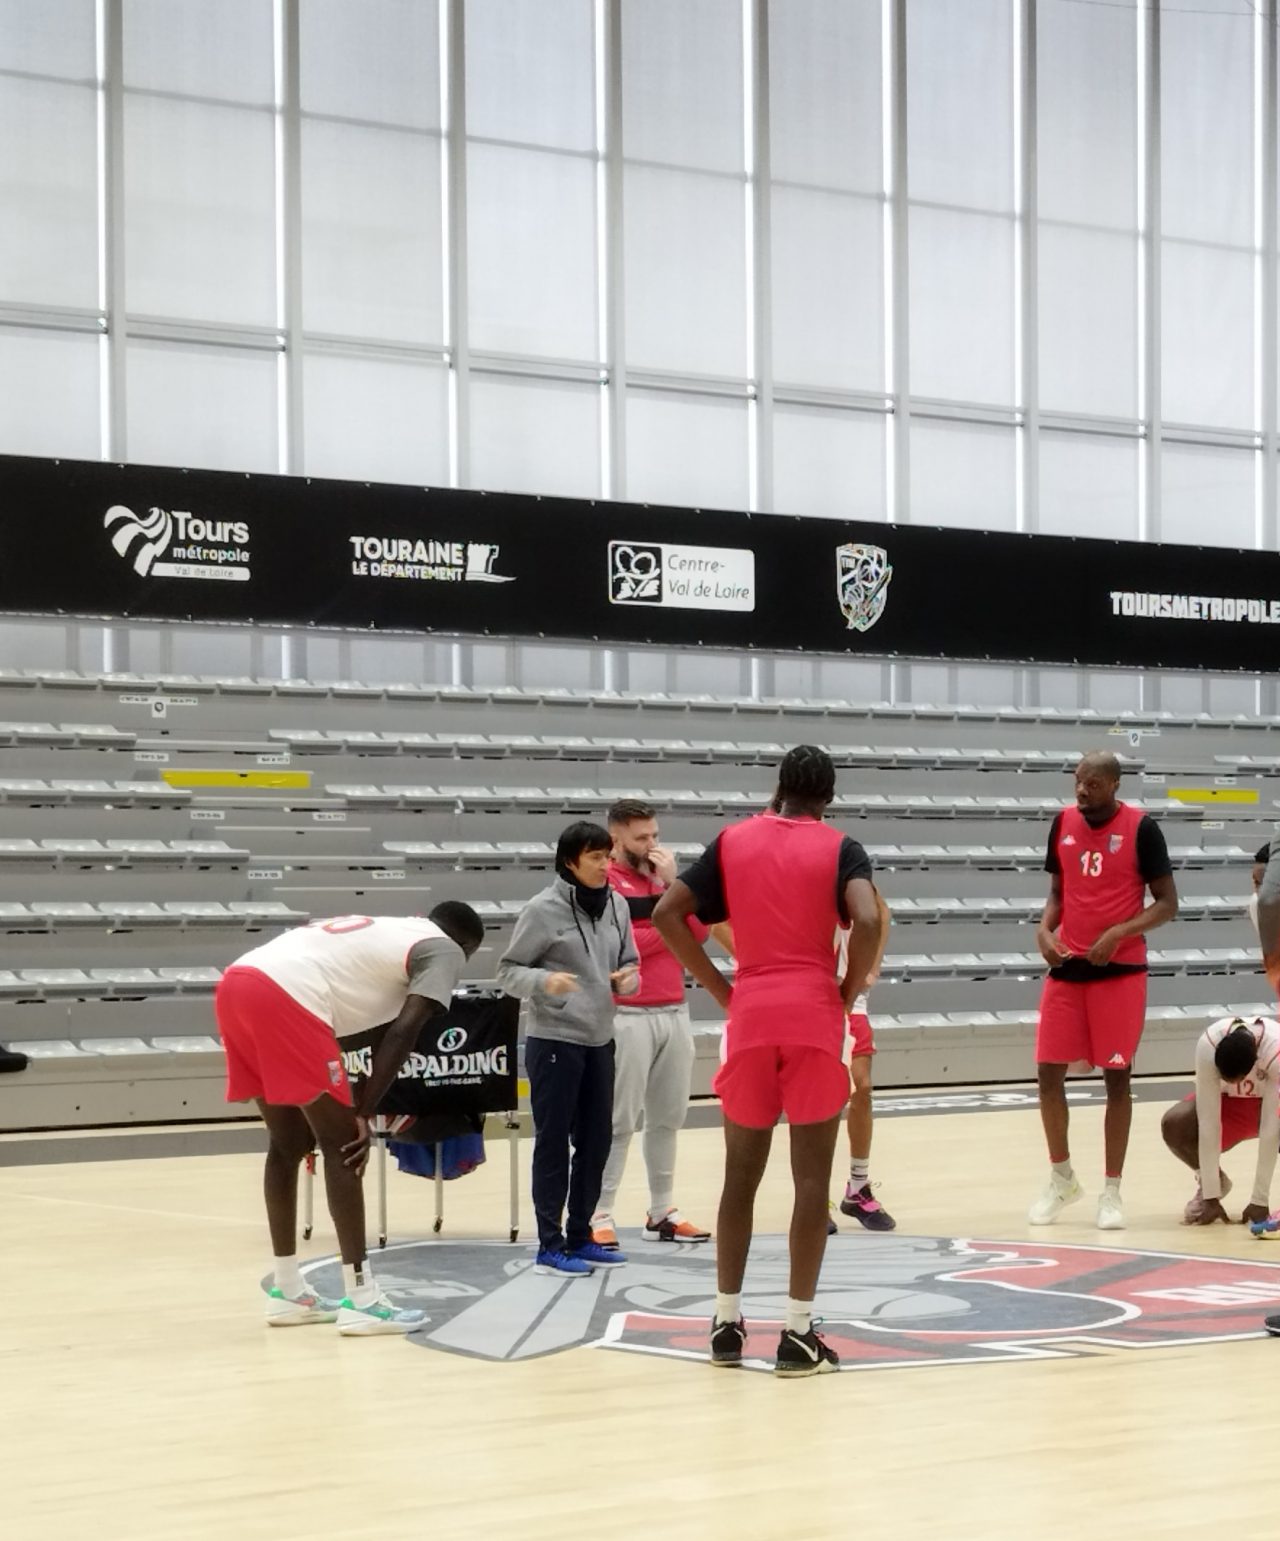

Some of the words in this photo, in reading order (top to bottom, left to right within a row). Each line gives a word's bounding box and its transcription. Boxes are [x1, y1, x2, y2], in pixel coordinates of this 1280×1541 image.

[171, 510, 250, 544] Tours
[173, 544, 250, 564] métropole
[349, 536, 464, 566] TOURAINE
[174, 565, 191, 575] Val
[194, 566, 206, 577] de
[209, 567, 234, 578] Loire
[352, 561, 369, 576] LE
[370, 560, 464, 582] DÉPARTEMENT
[668, 554, 726, 573] Centre-
[669, 579, 690, 597] Val
[694, 580, 711, 598] de
[715, 582, 750, 600] Loire
[1080, 850, 1104, 877] 13
[397, 1045, 510, 1080] SPALDING
